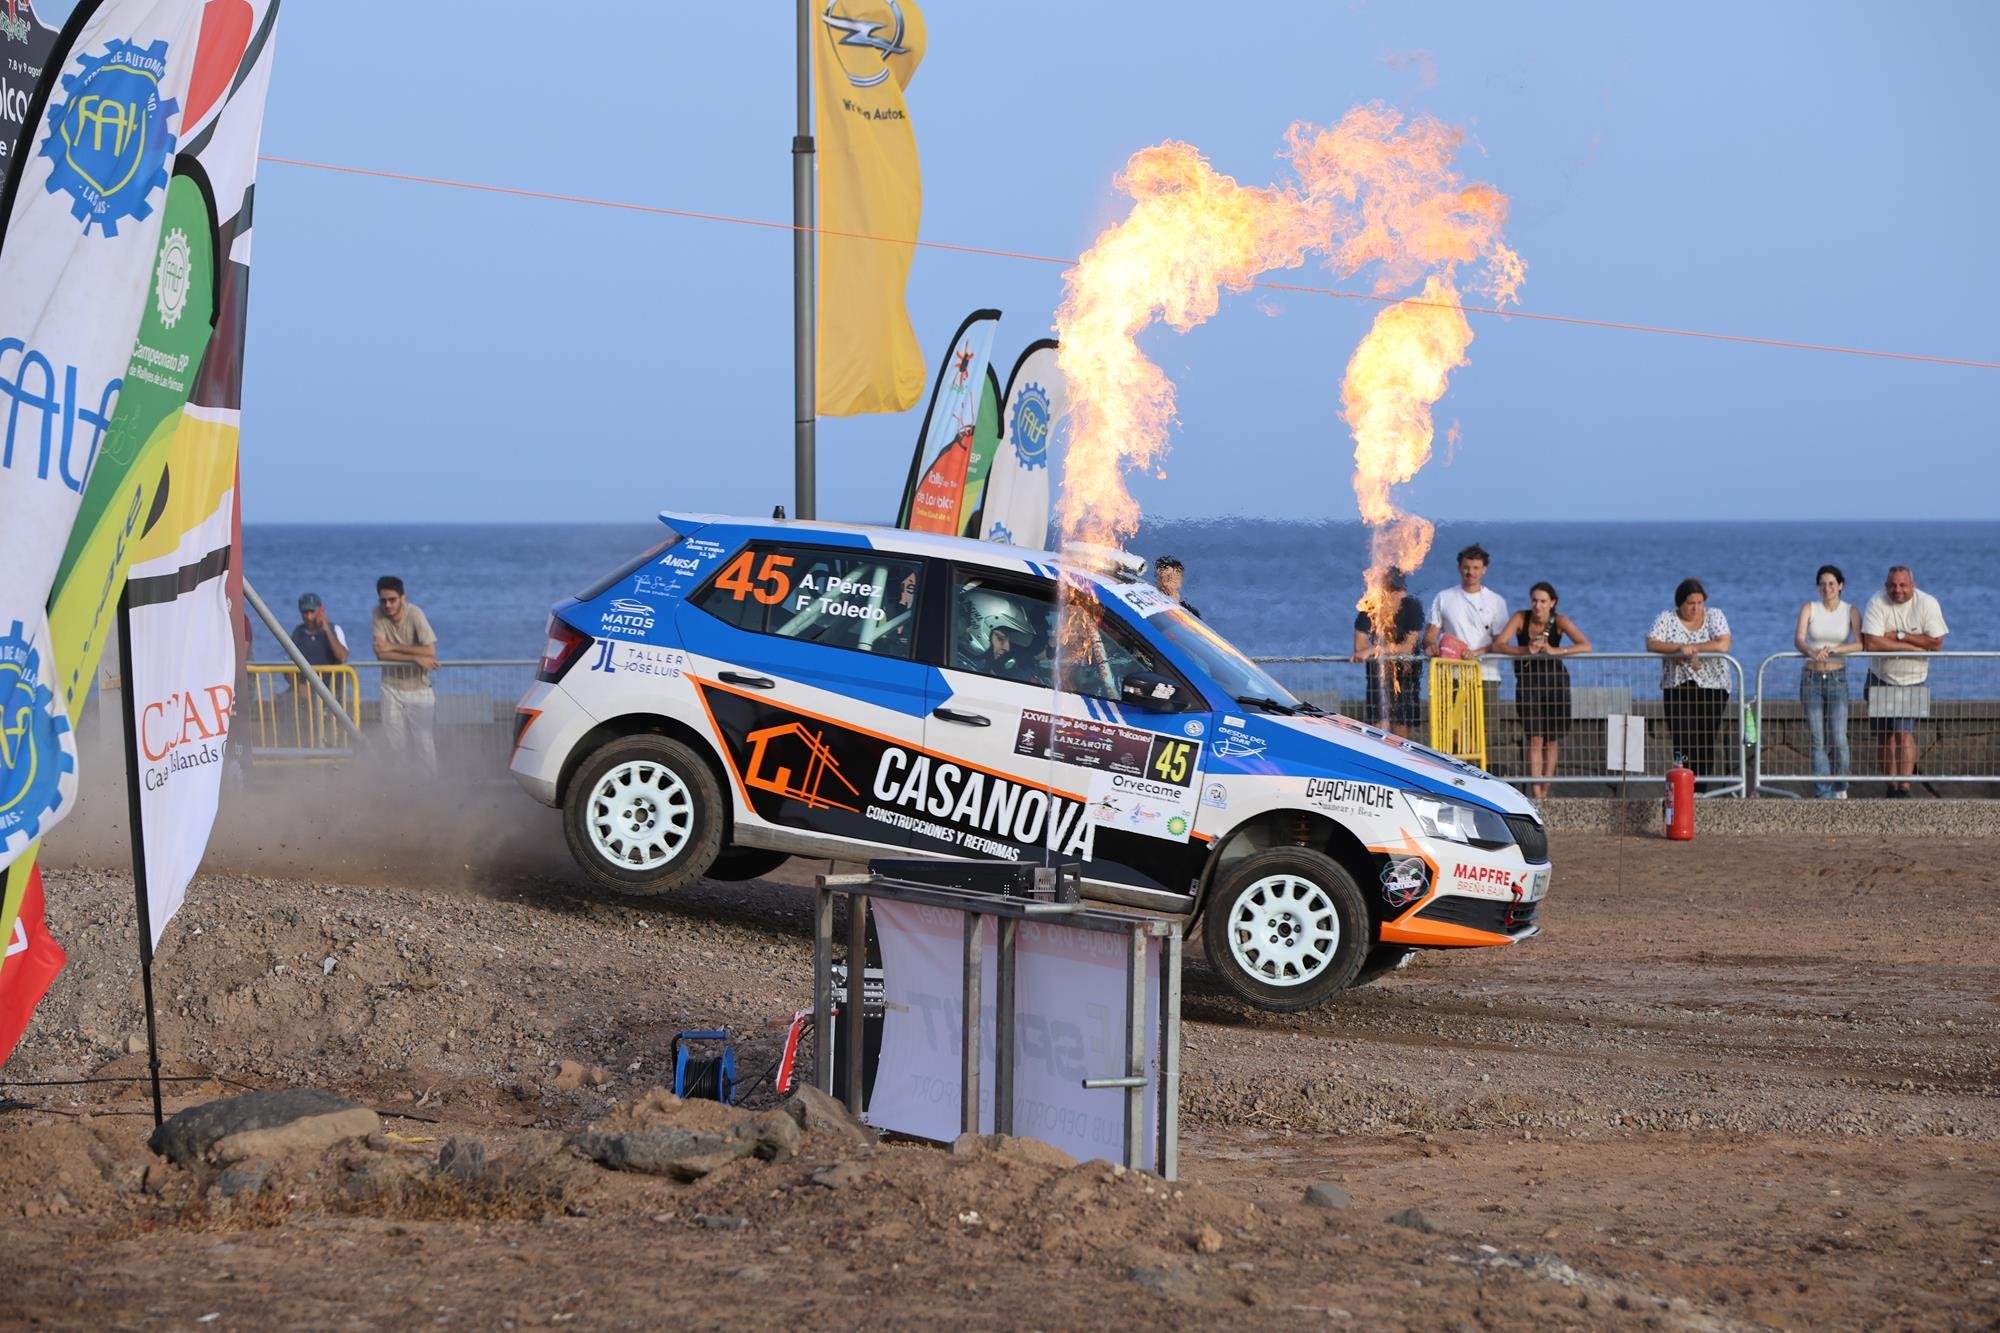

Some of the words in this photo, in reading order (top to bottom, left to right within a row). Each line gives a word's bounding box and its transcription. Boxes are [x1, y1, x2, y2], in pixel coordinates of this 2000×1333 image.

[873, 107, 906, 121] Autos.
[714, 551, 795, 605] 45
[799, 573, 819, 590] A.
[796, 594, 811, 611] F.
[820, 598, 886, 621] Toledo
[601, 613, 655, 629] MATOS
[602, 625, 647, 637] MOTOR
[591, 640, 616, 673] JL
[628, 648, 684, 665] TALLER
[654, 665, 681, 679] LUIS
[1055, 735, 1113, 752] LANZAROTE
[1155, 741, 1191, 783] 45
[1113, 775, 1182, 799] Orvecame
[872, 747, 1096, 863] CASANOVA
[866, 805, 954, 842] CONSTRUCCIONES
[954, 831, 963, 846] Y
[963, 834, 1020, 862] REFORMAS
[1453, 863, 1511, 887] MAPFRE
